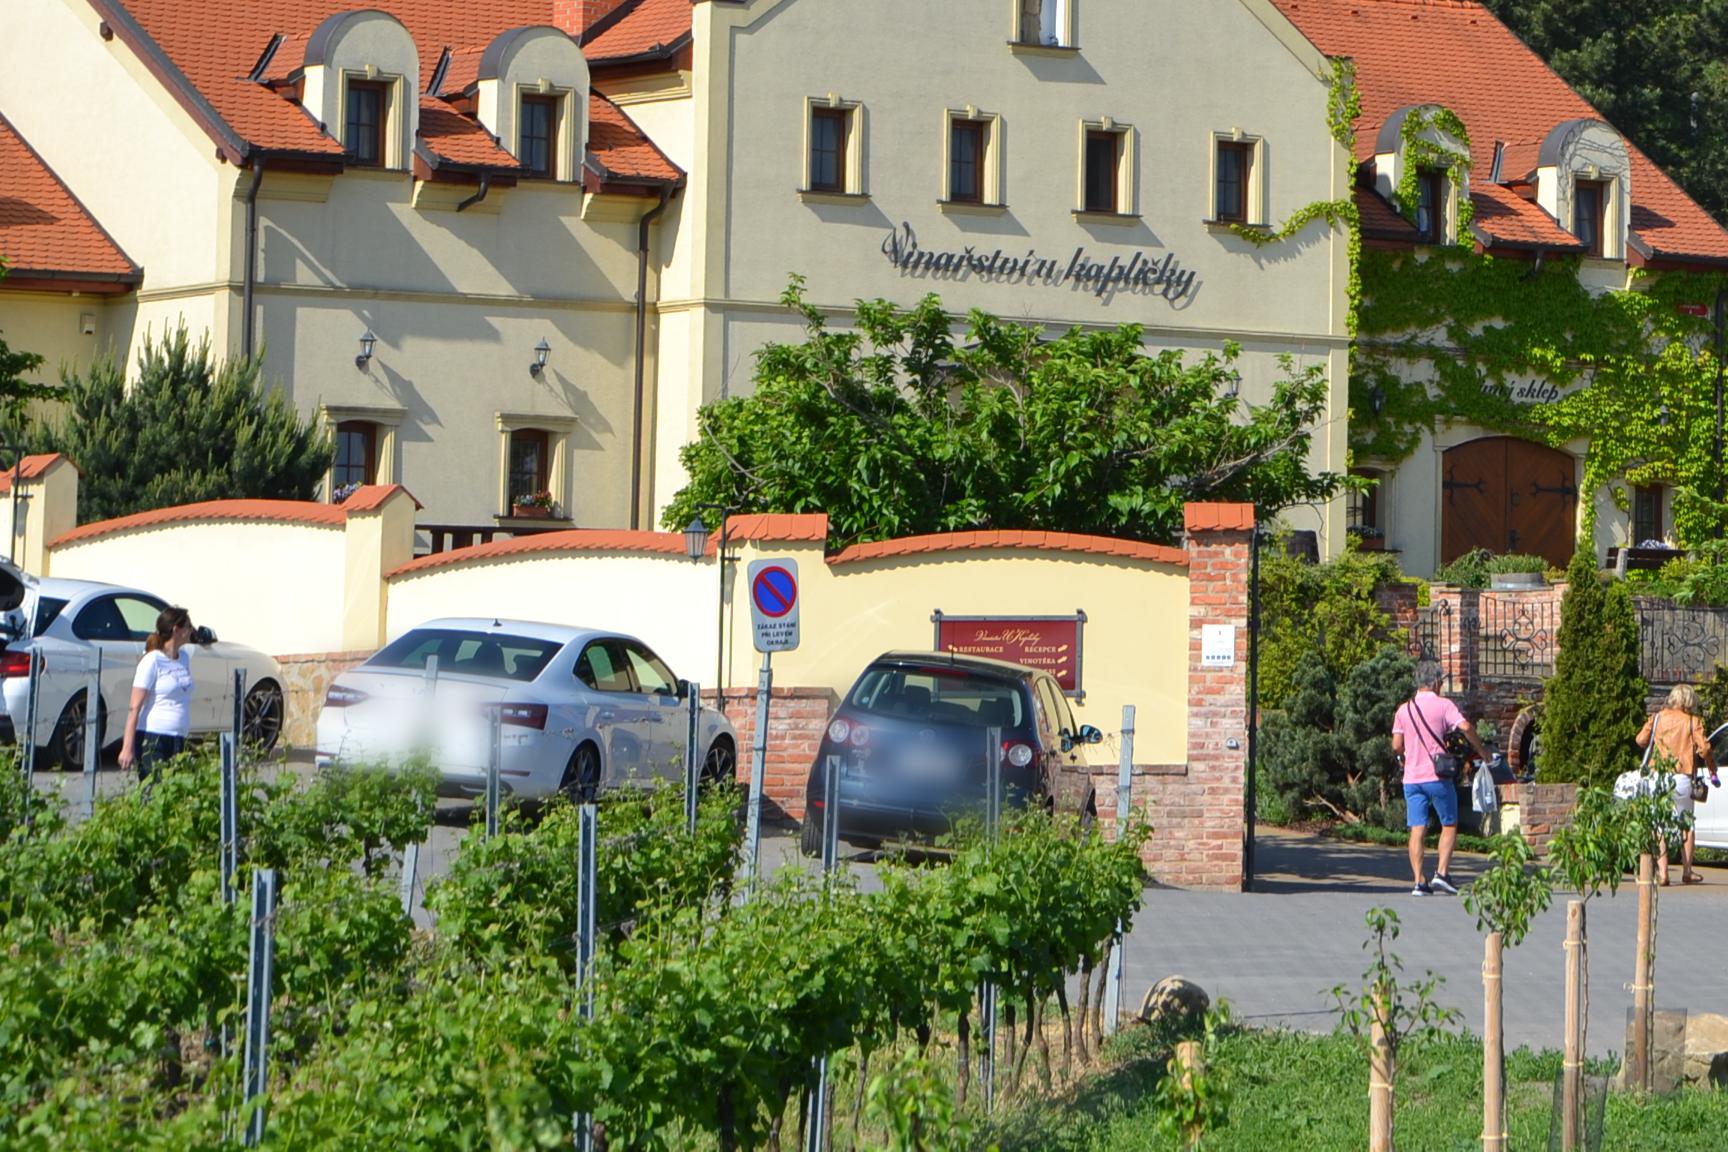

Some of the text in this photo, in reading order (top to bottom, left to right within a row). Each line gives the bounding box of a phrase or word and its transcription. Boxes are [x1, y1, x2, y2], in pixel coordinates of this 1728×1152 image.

[881, 221, 1196, 302] Vinařství u kapličky
[1516, 379, 1559, 403] sklep
